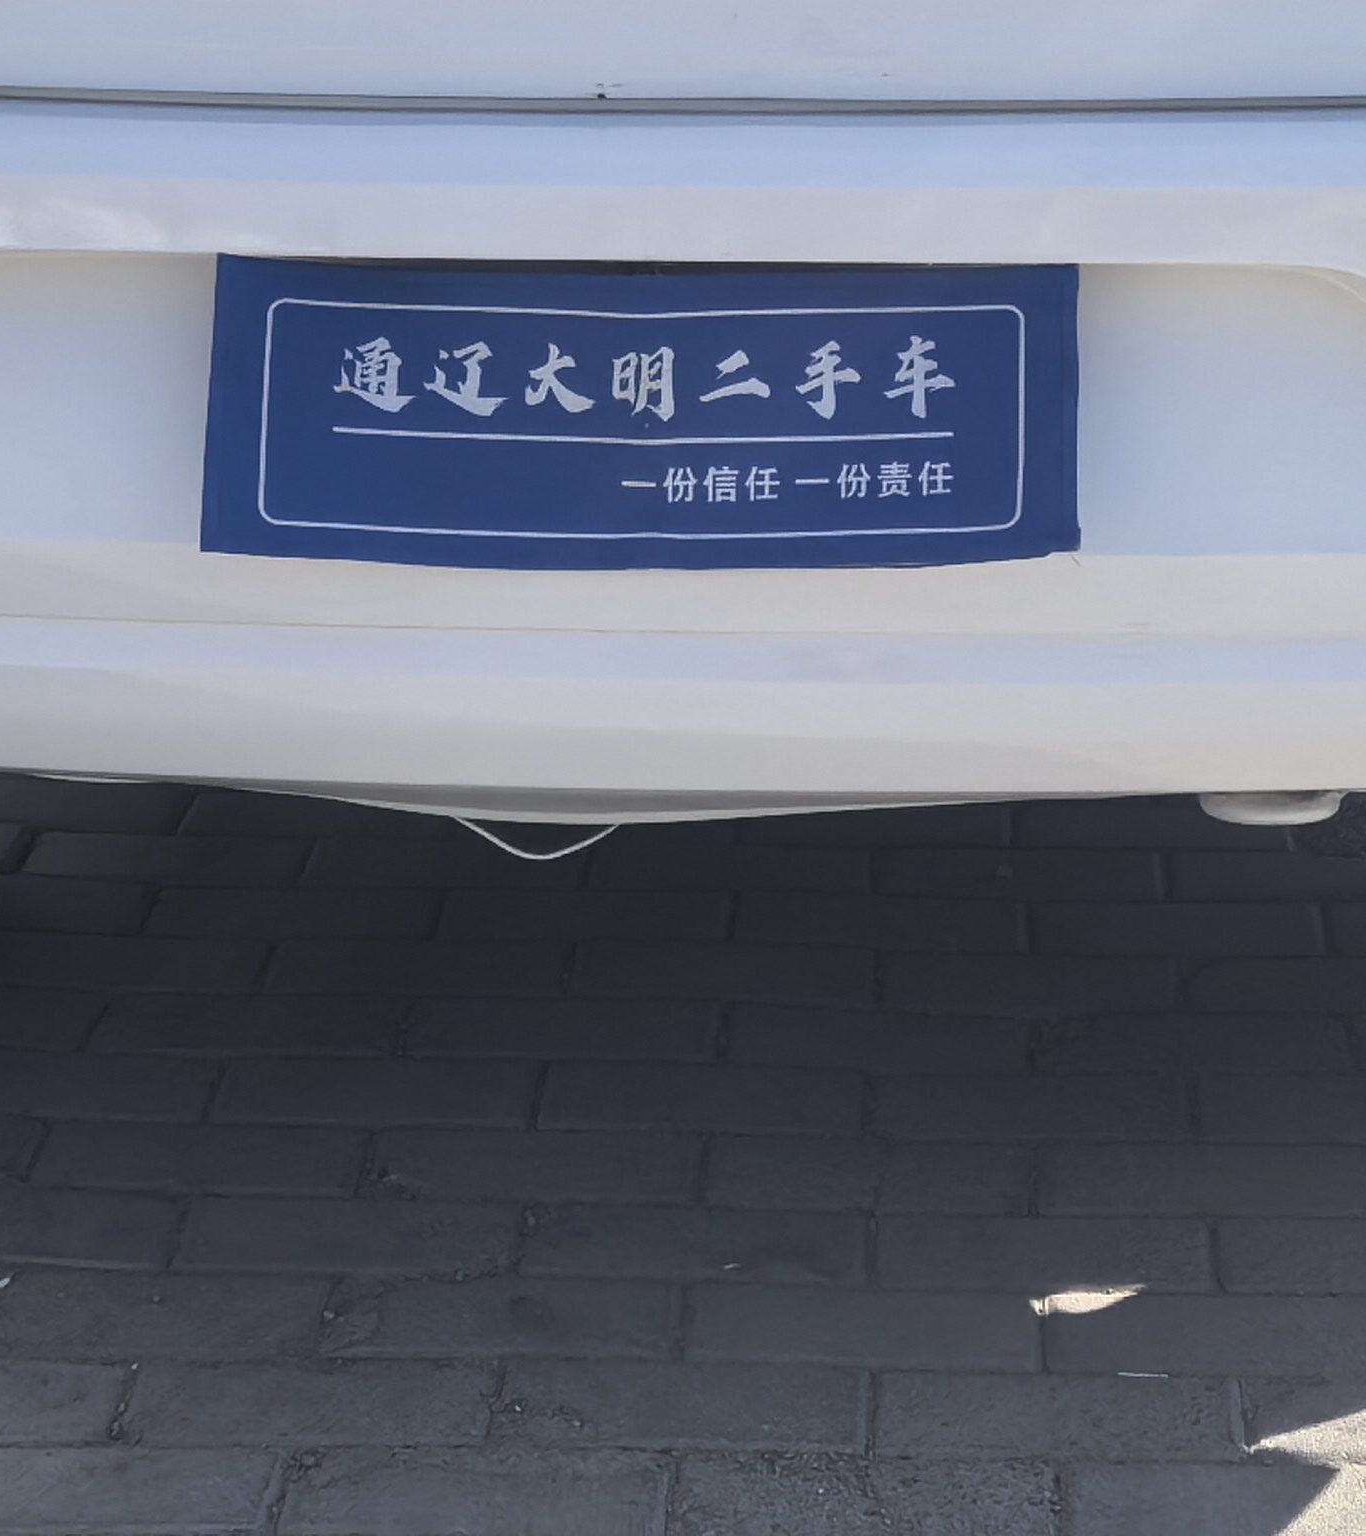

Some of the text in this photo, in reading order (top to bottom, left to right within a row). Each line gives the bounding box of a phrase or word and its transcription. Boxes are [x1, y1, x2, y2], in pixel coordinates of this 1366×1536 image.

[333, 336, 957, 420] 通辽大明二手车
[620, 461, 956, 504] 一份信任 一份责任
